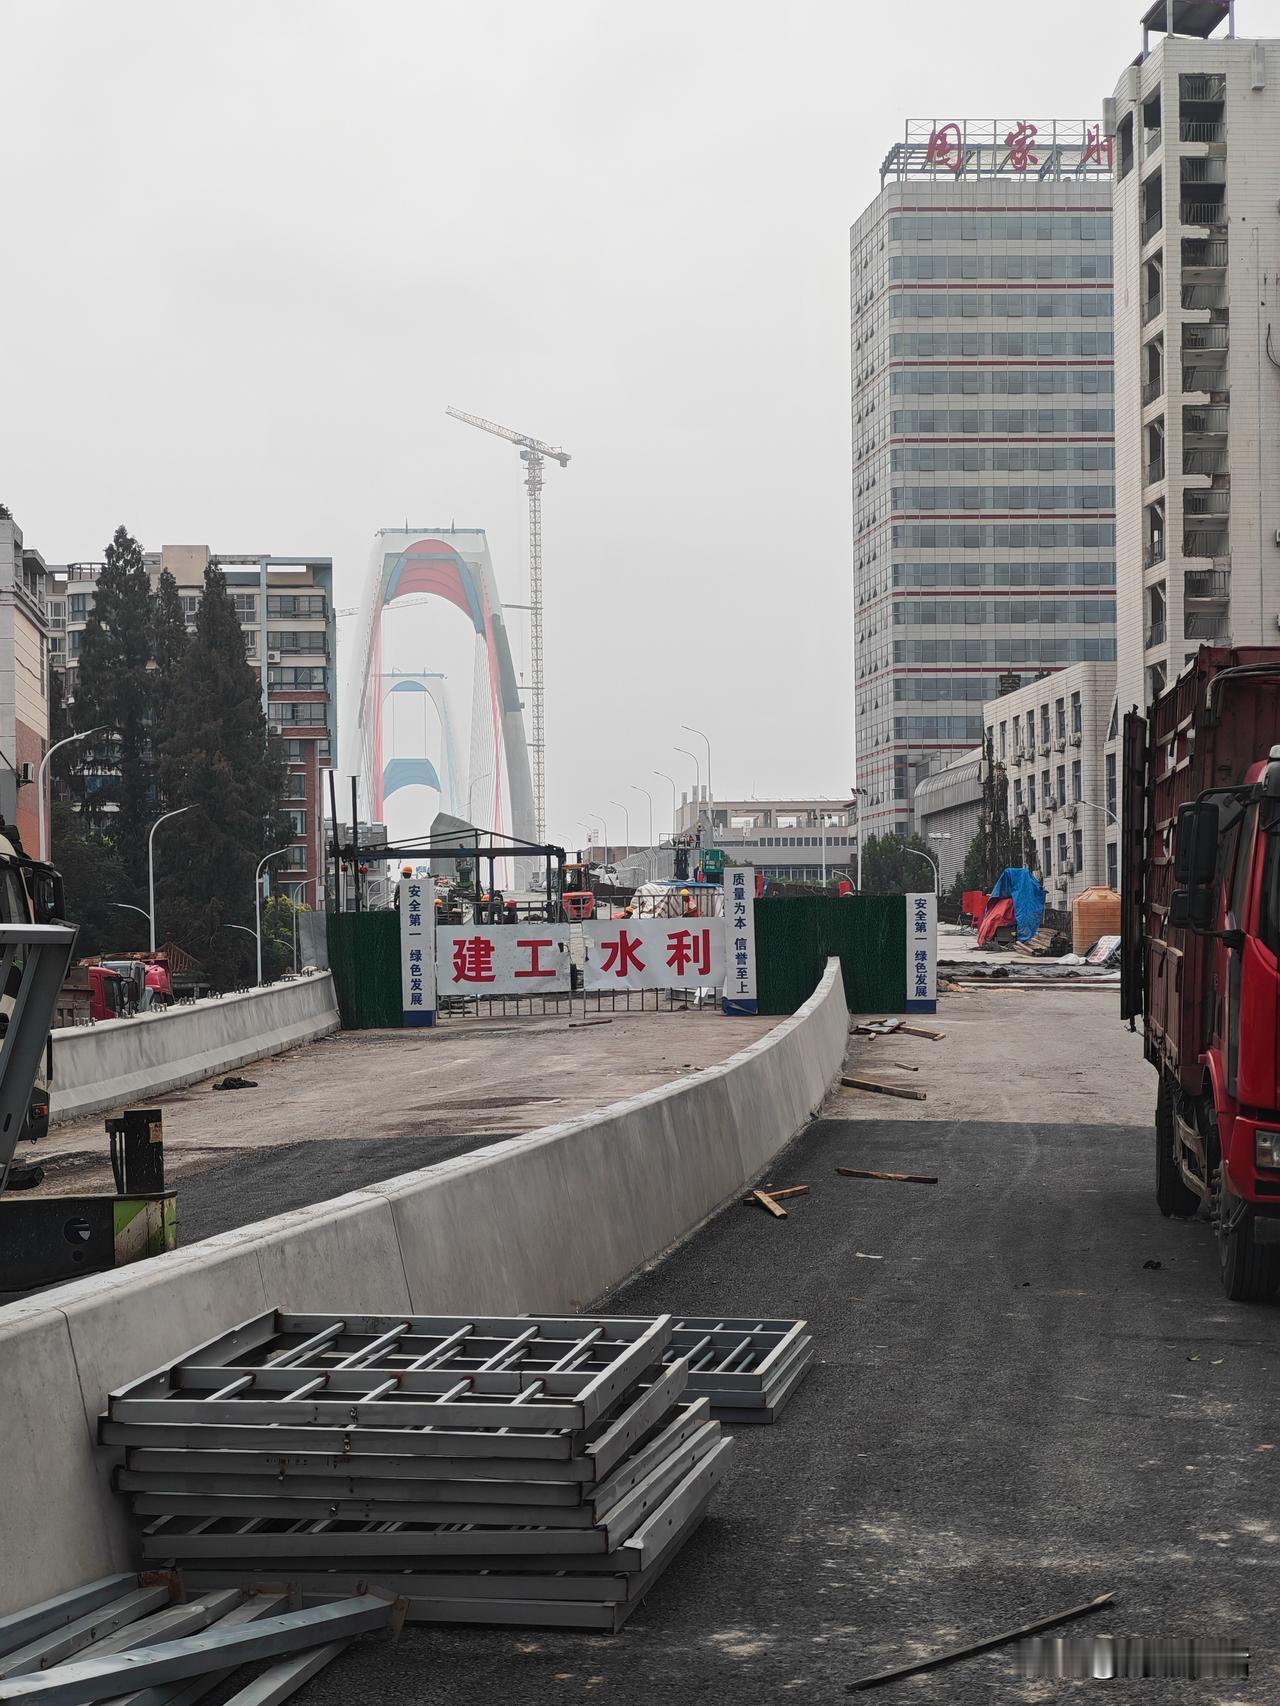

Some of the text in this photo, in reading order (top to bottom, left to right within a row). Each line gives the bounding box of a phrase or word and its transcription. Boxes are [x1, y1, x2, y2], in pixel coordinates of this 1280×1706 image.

[407, 884, 424, 1007] 安全第一 绿色发展
[452, 928, 711, 983] 建工 水利
[732, 872, 750, 994] 质量为本 信誉至上
[914, 898, 928, 998] 安全第一 绿色发展
